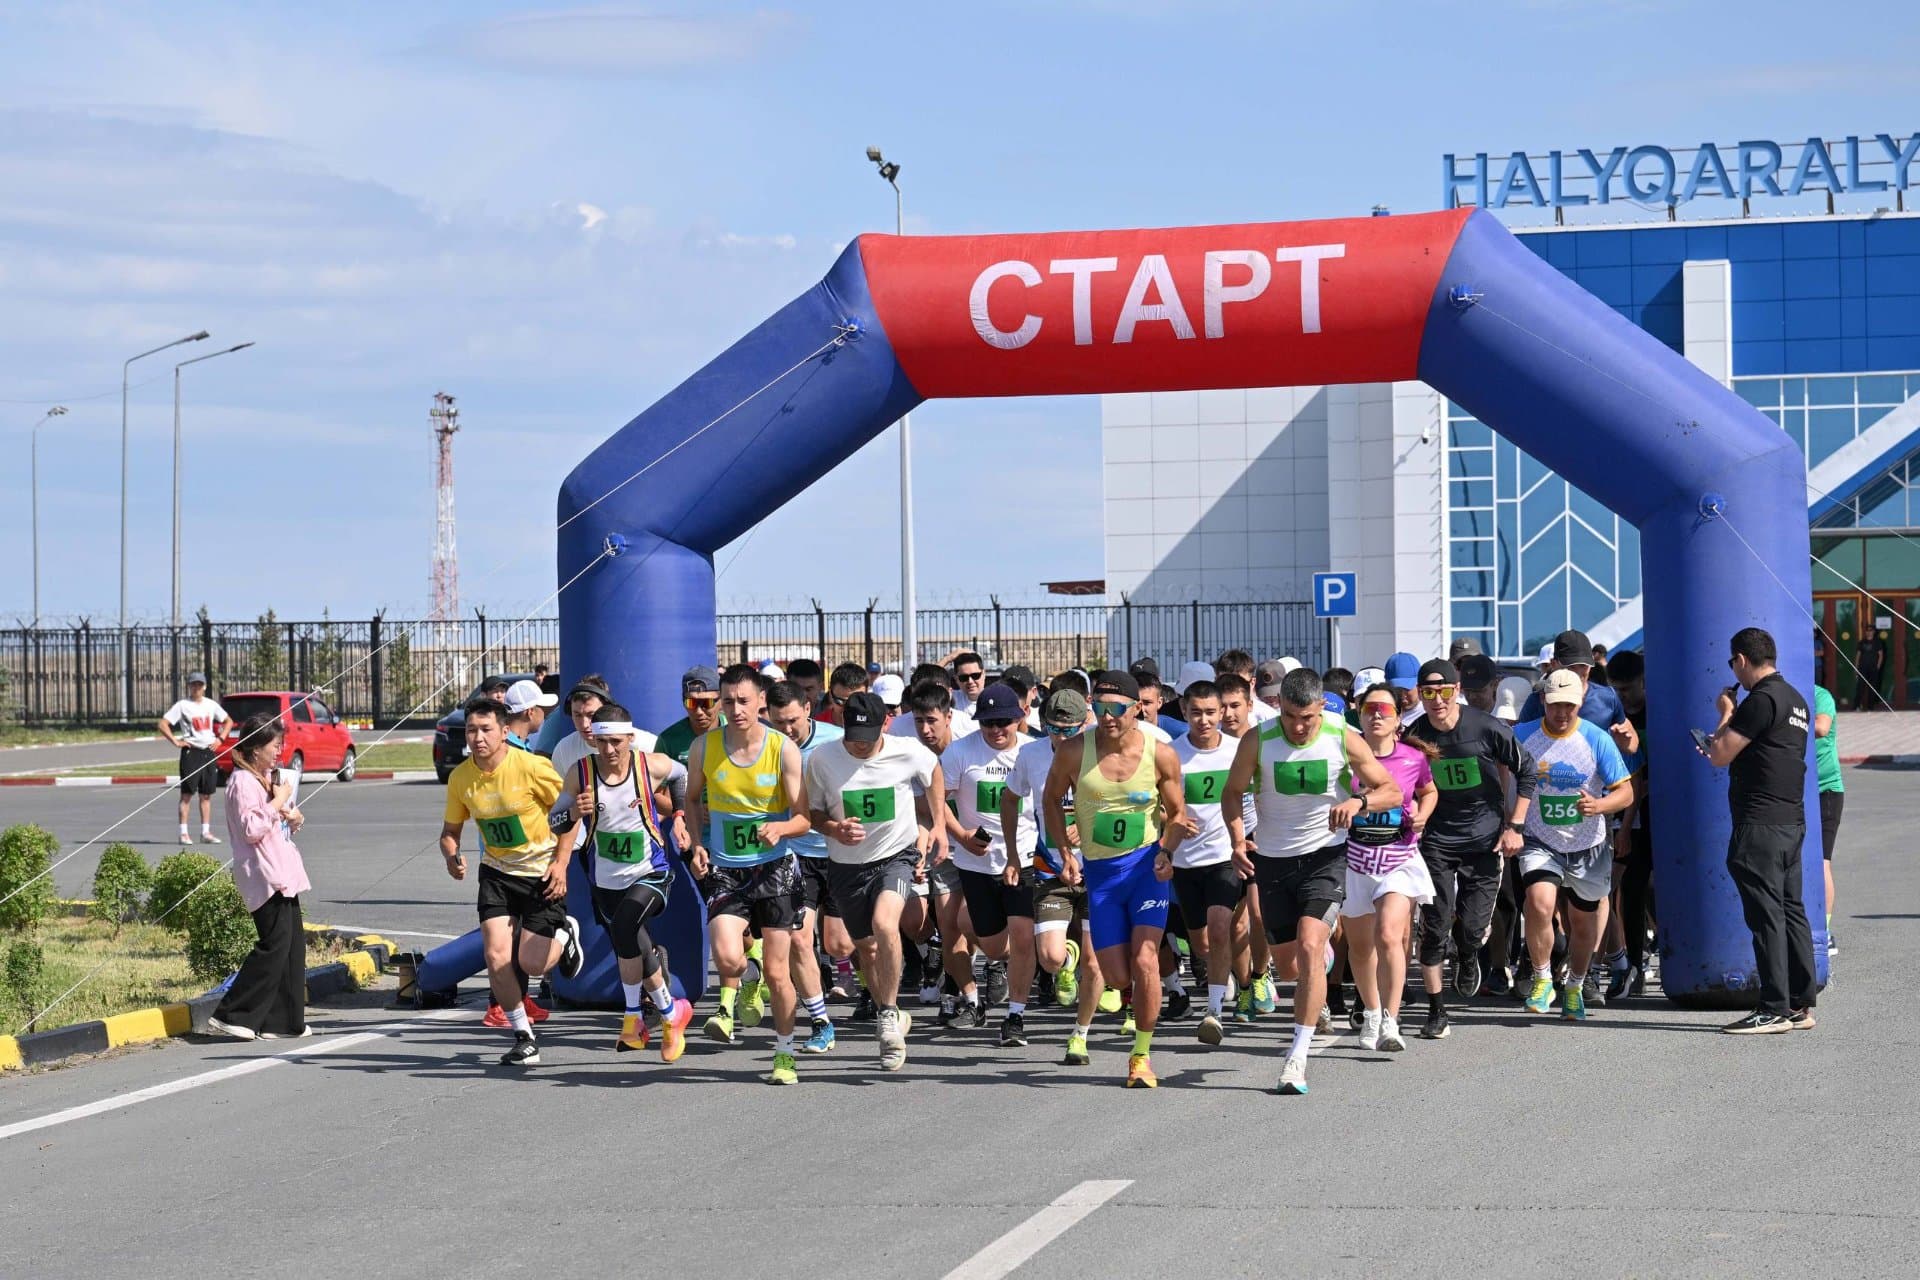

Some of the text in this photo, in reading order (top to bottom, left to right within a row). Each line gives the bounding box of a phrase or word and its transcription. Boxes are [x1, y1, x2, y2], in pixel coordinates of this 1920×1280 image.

[1443, 132, 1920, 209] HALYQARALY
[969, 243, 1346, 350] СТАРТ
[1323, 578, 1347, 612] P
[1297, 766, 1306, 790] 1
[1443, 763, 1468, 786] 15
[1203, 775, 1215, 799] 2
[862, 793, 876, 818] 5
[1543, 803, 1578, 819] 256
[487, 821, 513, 844] 30
[733, 823, 761, 851] 54
[1112, 818, 1127, 843] 9
[607, 836, 633, 859] 44
